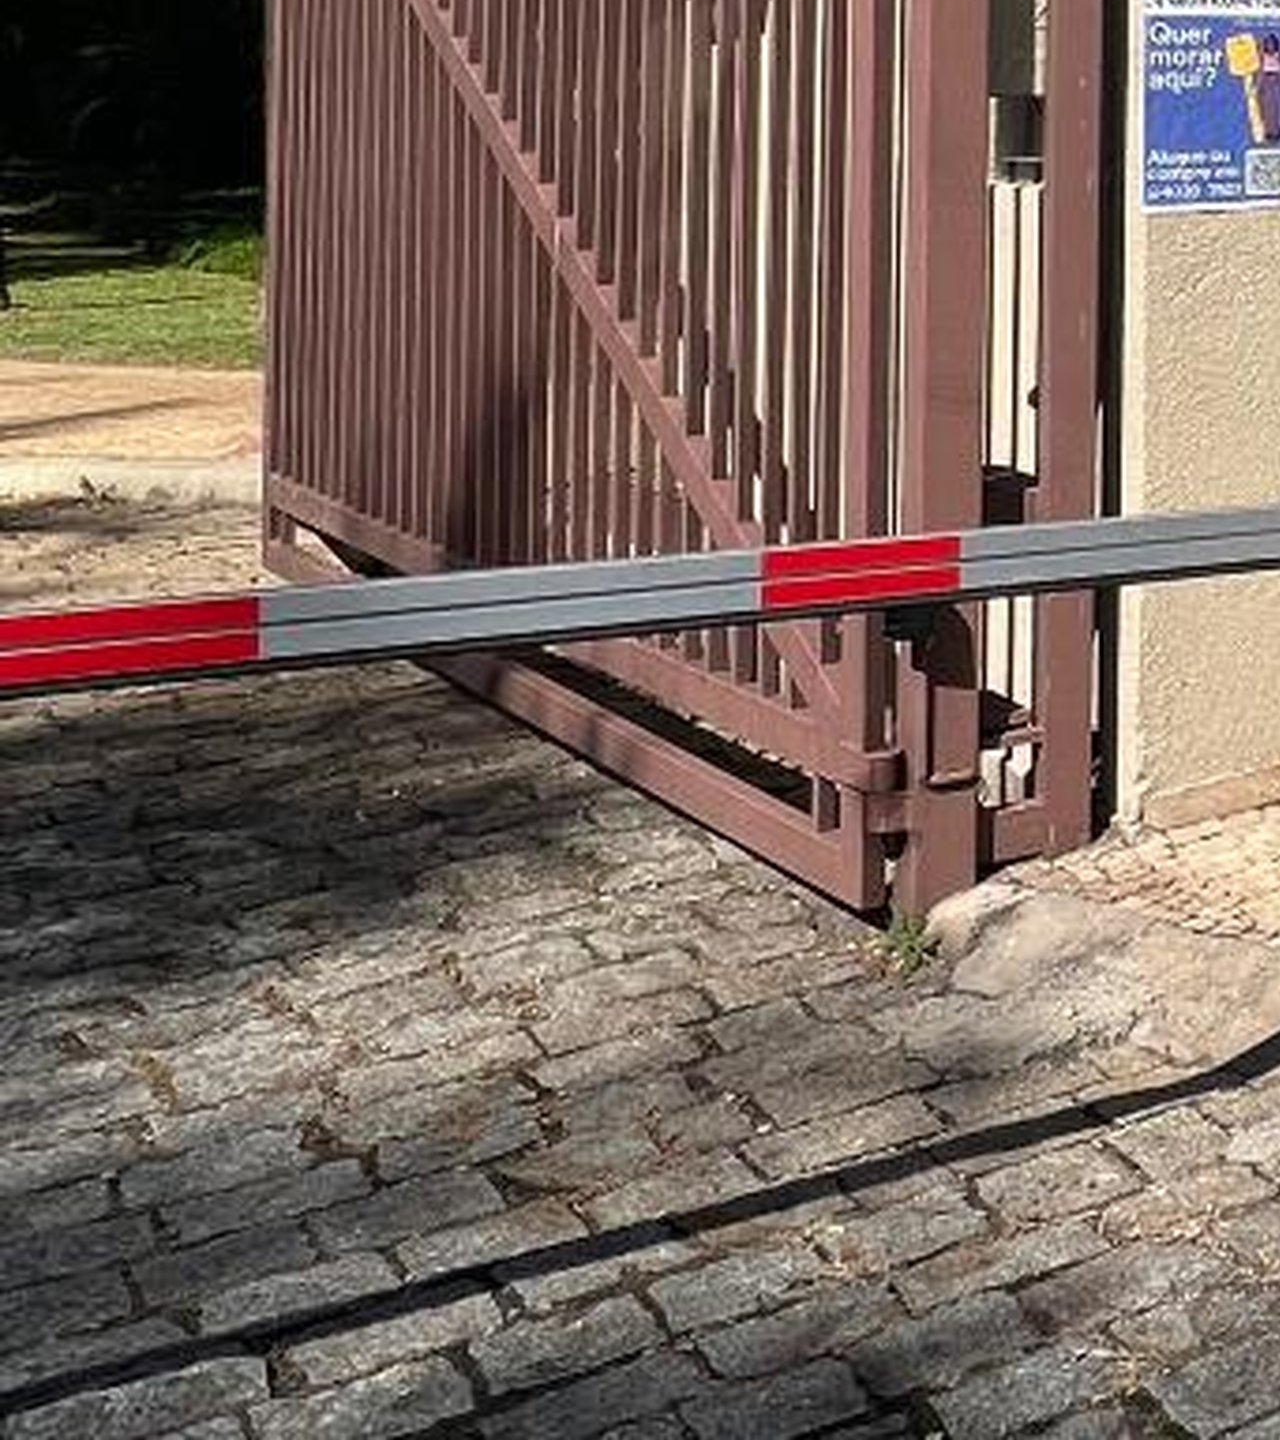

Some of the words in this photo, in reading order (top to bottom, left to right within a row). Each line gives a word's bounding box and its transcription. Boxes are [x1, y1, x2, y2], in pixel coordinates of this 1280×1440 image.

[1151, 22, 1211, 45] Quer
[1150, 48, 1222, 66] morar
[1149, 67, 1217, 94] aqui?
